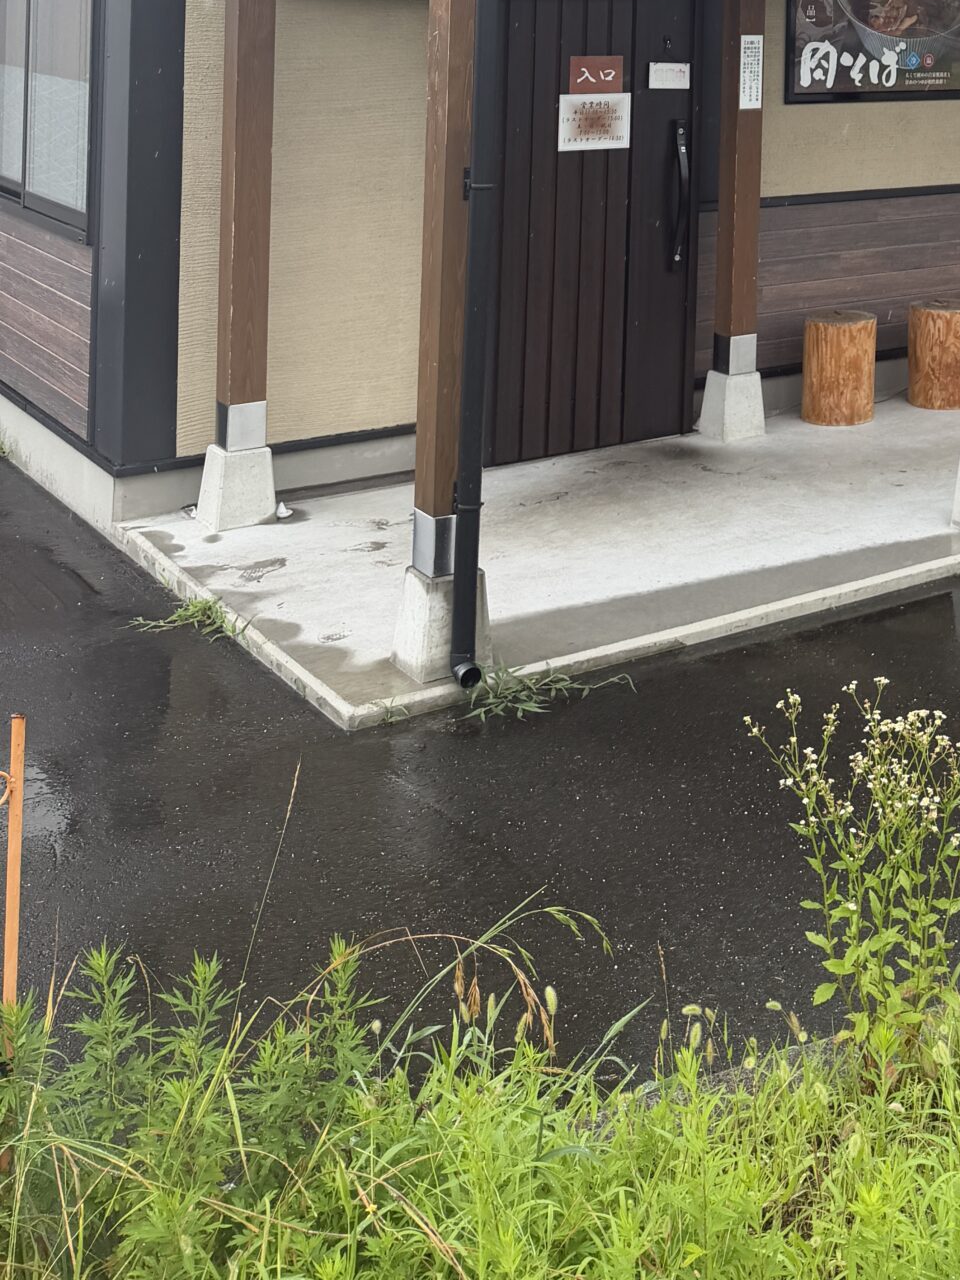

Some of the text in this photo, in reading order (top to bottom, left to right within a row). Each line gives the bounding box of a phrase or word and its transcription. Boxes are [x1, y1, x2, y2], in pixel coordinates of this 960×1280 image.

[577, 67, 616, 83] 入口
[800, 40, 906, 88] 肉そば
